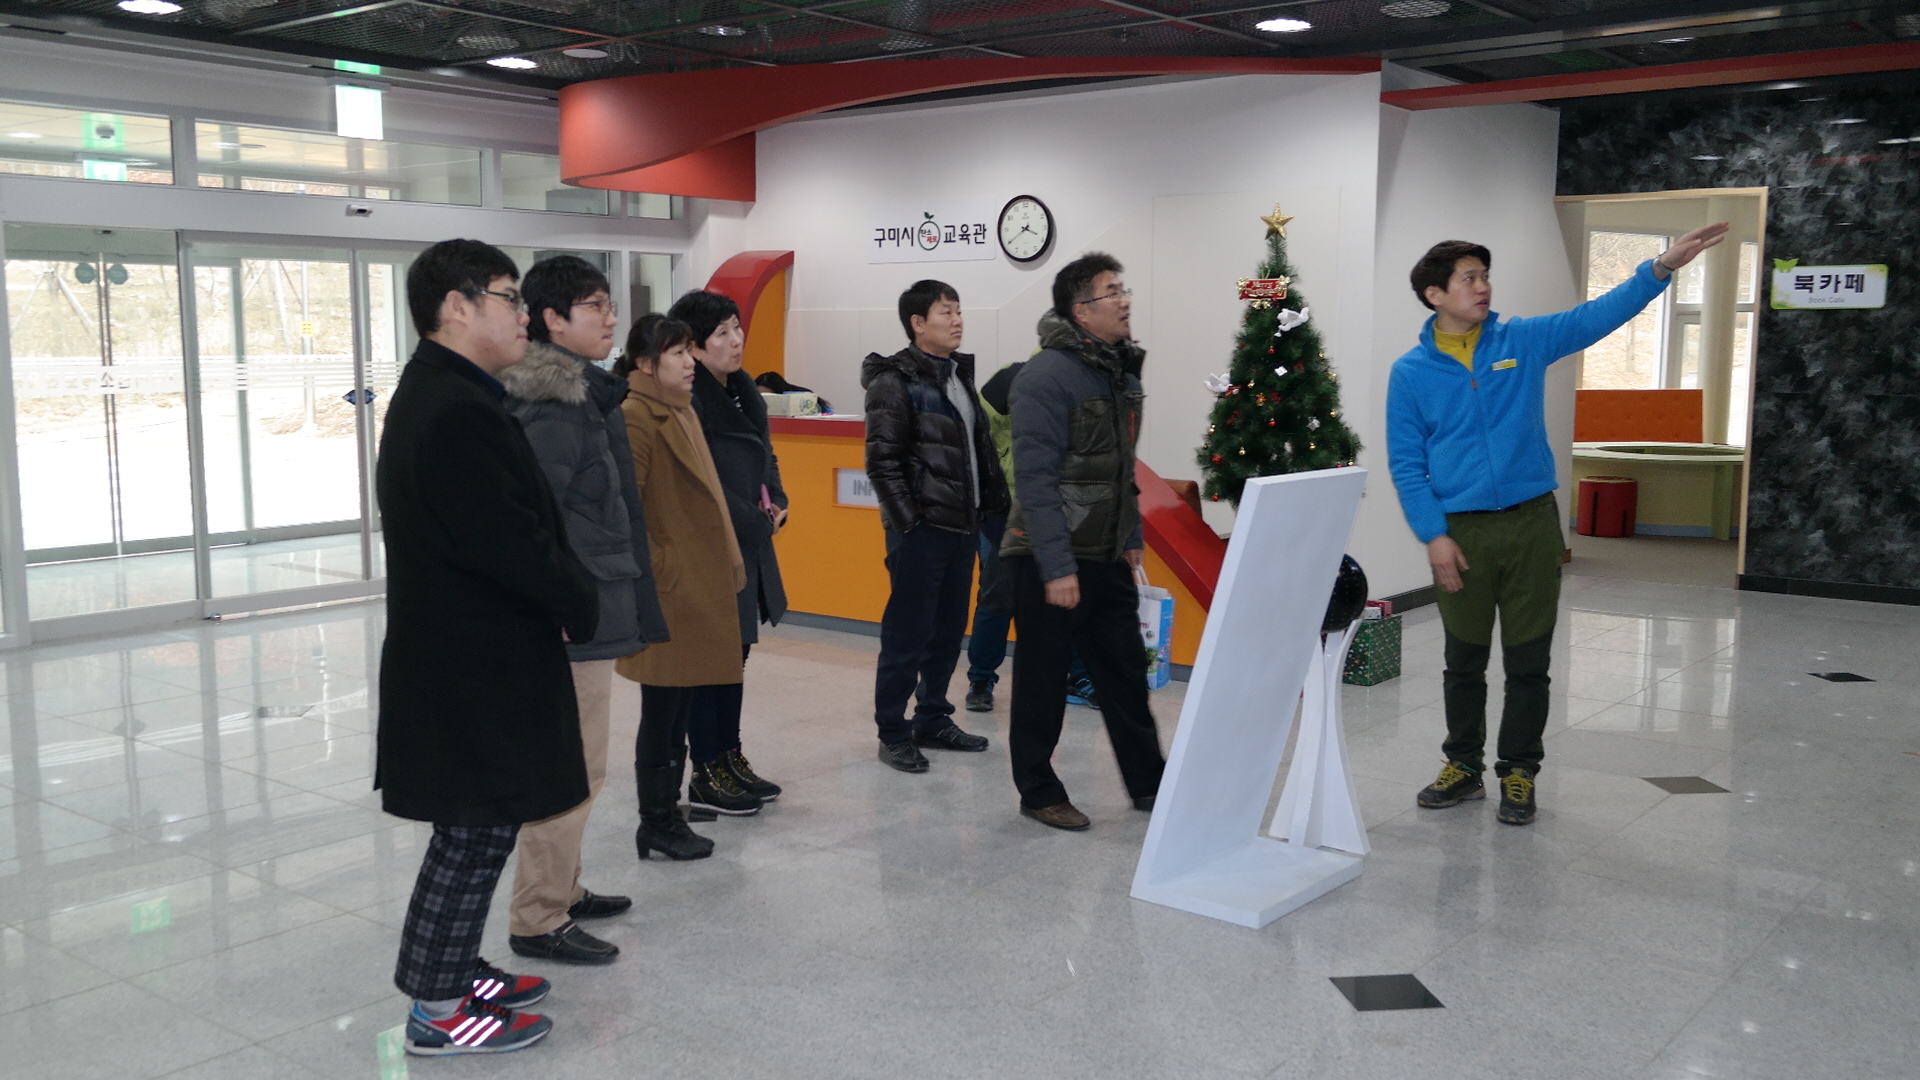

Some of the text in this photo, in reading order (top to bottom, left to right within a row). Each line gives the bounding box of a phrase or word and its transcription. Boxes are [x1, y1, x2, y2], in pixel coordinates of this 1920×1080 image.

[874, 227, 914, 248] 구미시
[943, 223, 987, 245] 교육관
[1794, 274, 1865, 293] 북카페
